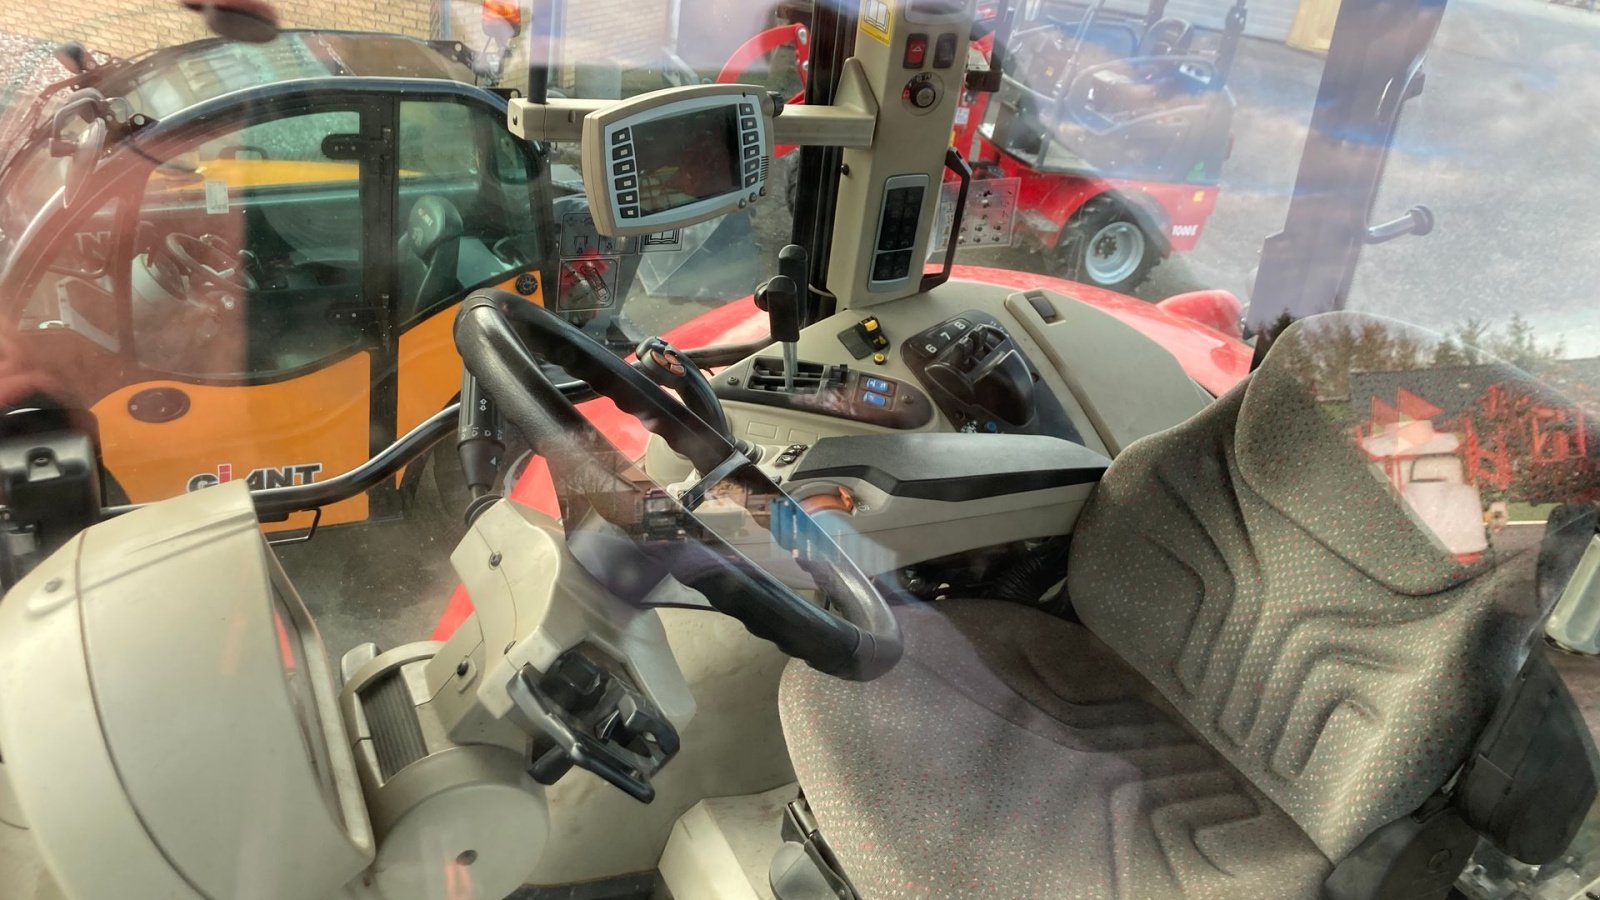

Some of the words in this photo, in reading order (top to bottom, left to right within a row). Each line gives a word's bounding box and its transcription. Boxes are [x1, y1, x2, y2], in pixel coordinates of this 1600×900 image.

[925, 343, 938, 354] 6
[940, 331, 951, 341] 7
[954, 321, 966, 330] 8
